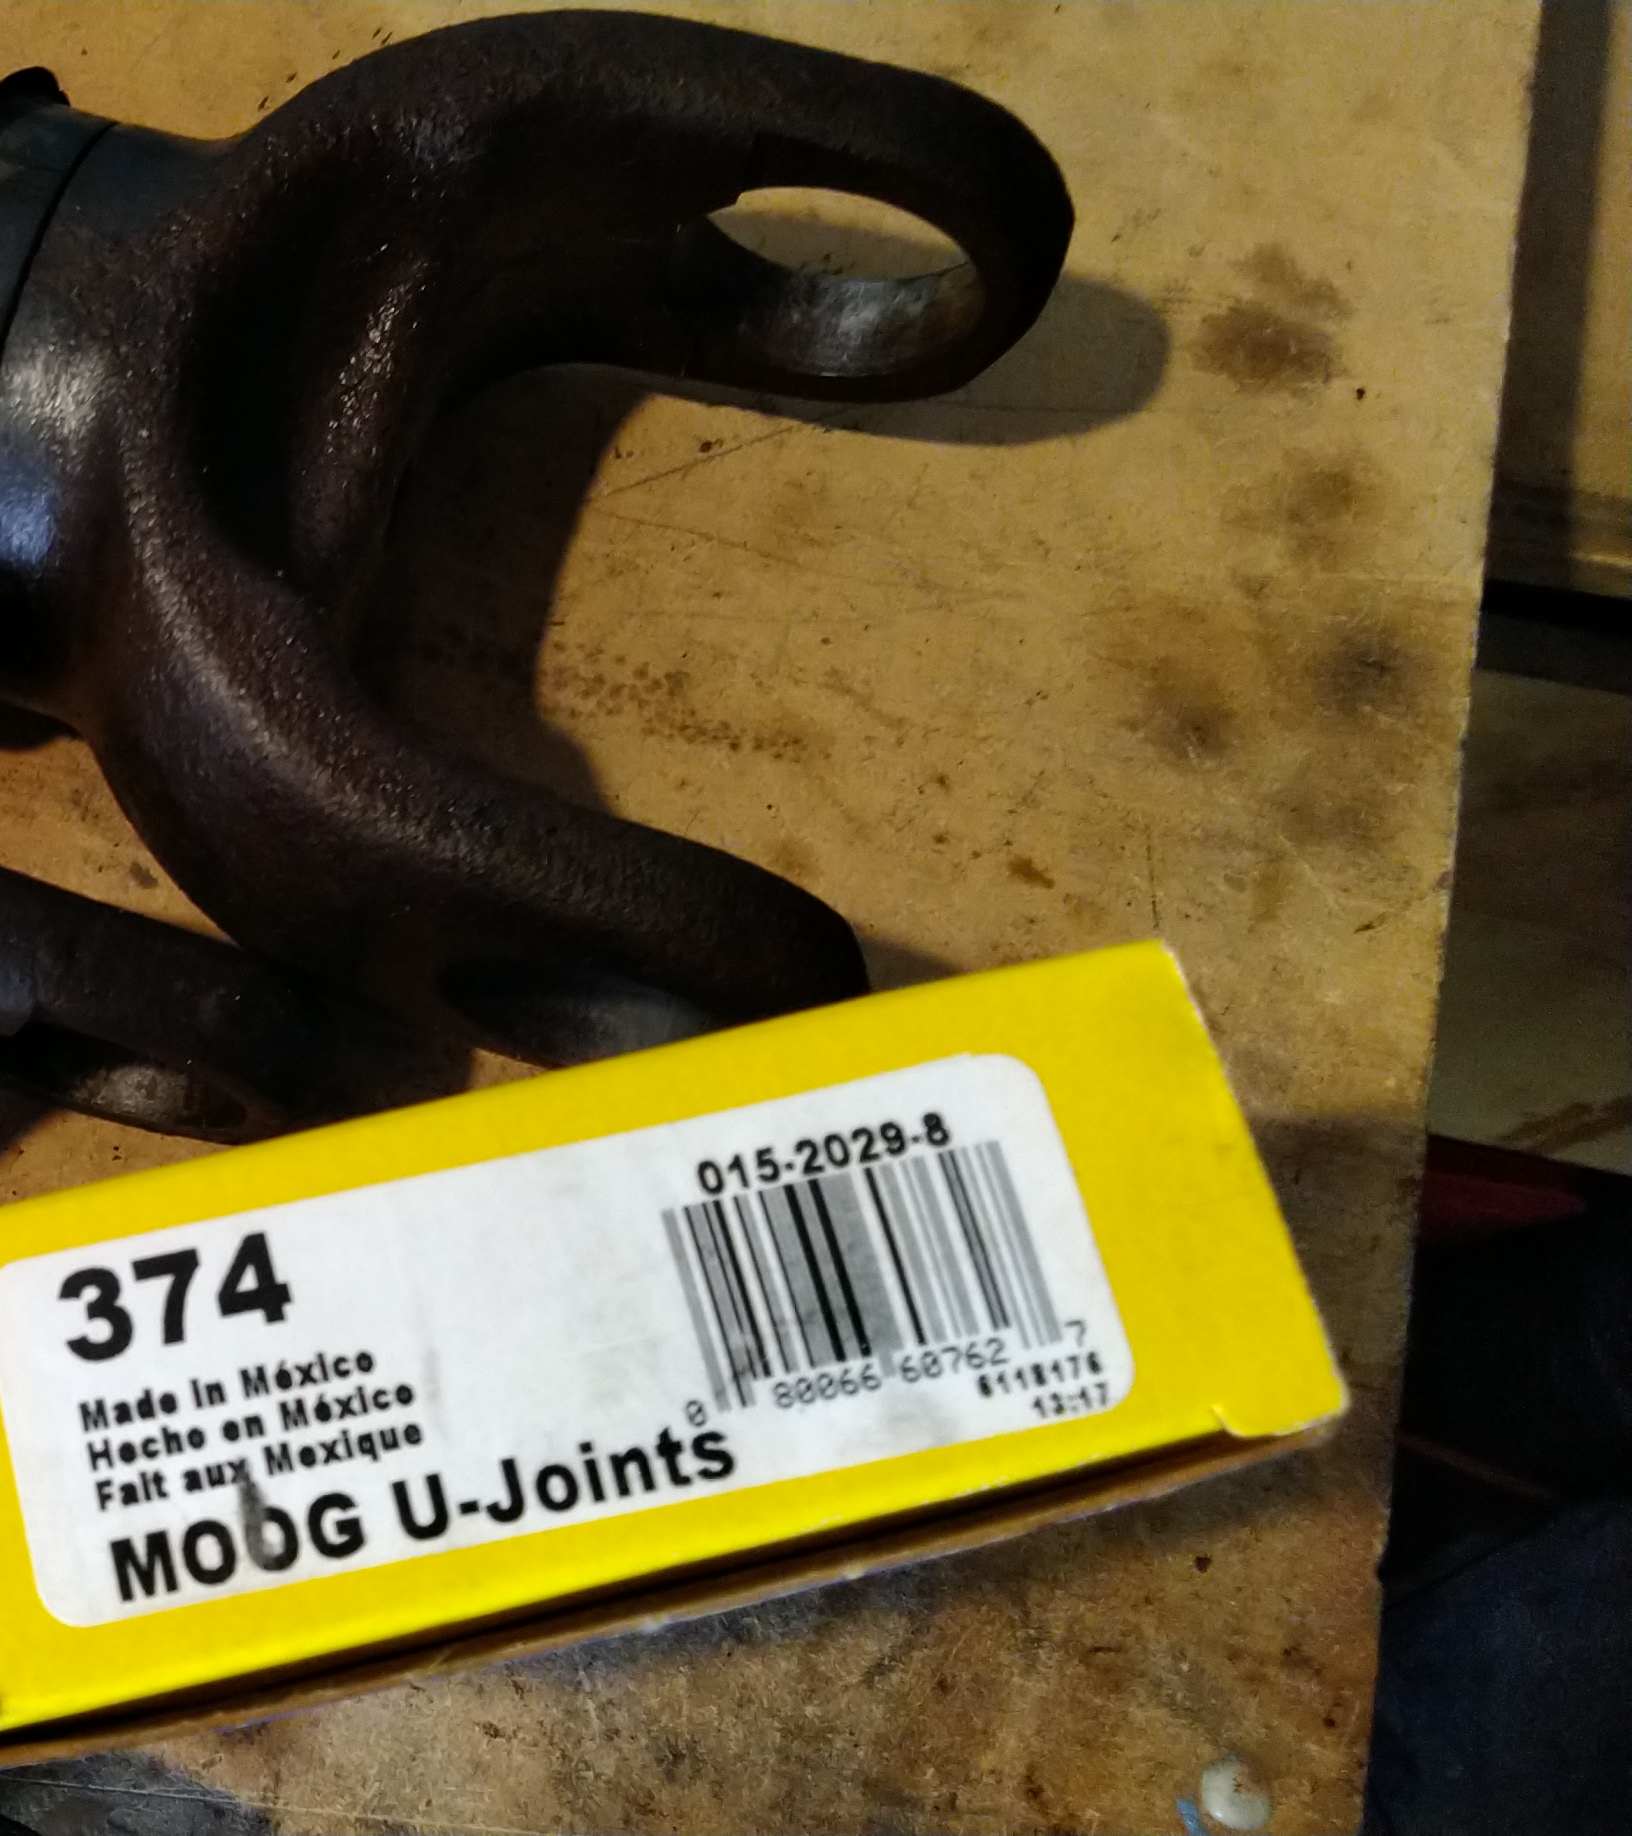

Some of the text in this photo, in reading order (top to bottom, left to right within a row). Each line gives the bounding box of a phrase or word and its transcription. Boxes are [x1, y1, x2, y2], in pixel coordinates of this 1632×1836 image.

[697, 1112, 952, 1195] 015-2029-8
[58, 1231, 292, 1361] 374
[79, 1390, 178, 1432] Made
[240, 1350, 375, 1399] México
[773, 1365, 882, 1411] 80066
[901, 1338, 1010, 1385] 60762
[1065, 1319, 1086, 1347] 7
[87, 1383, 415, 1472] Hecho en México
[96, 1420, 424, 1511] Fait aux Mexique
[110, 1426, 736, 1602] MOOG U-Joints
